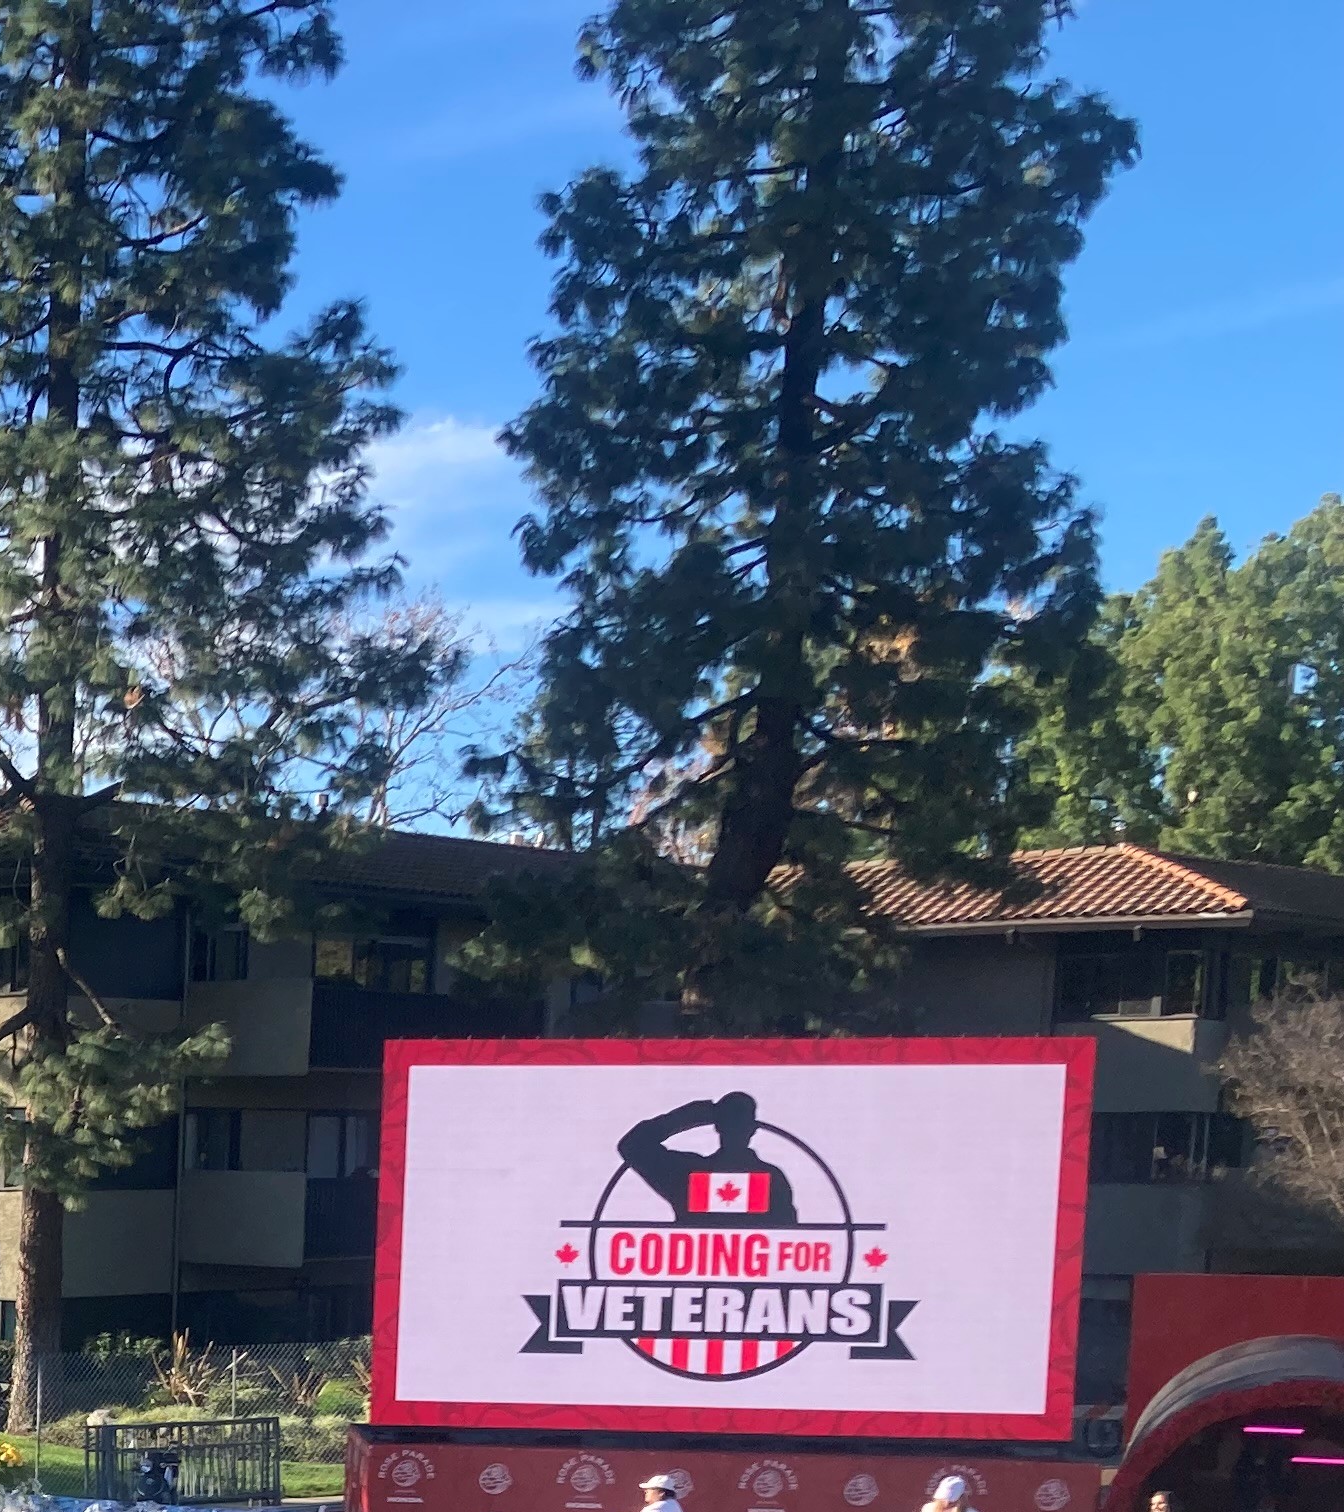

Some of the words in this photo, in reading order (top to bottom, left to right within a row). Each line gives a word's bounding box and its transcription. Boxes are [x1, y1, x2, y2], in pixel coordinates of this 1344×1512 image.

[609, 1232, 769, 1278] CODING
[777, 1241, 831, 1272] FOR
[561, 1285, 873, 1336] VETERANS
[402, 1450, 436, 1480] PARADE
[580, 1454, 615, 1485] PARADE
